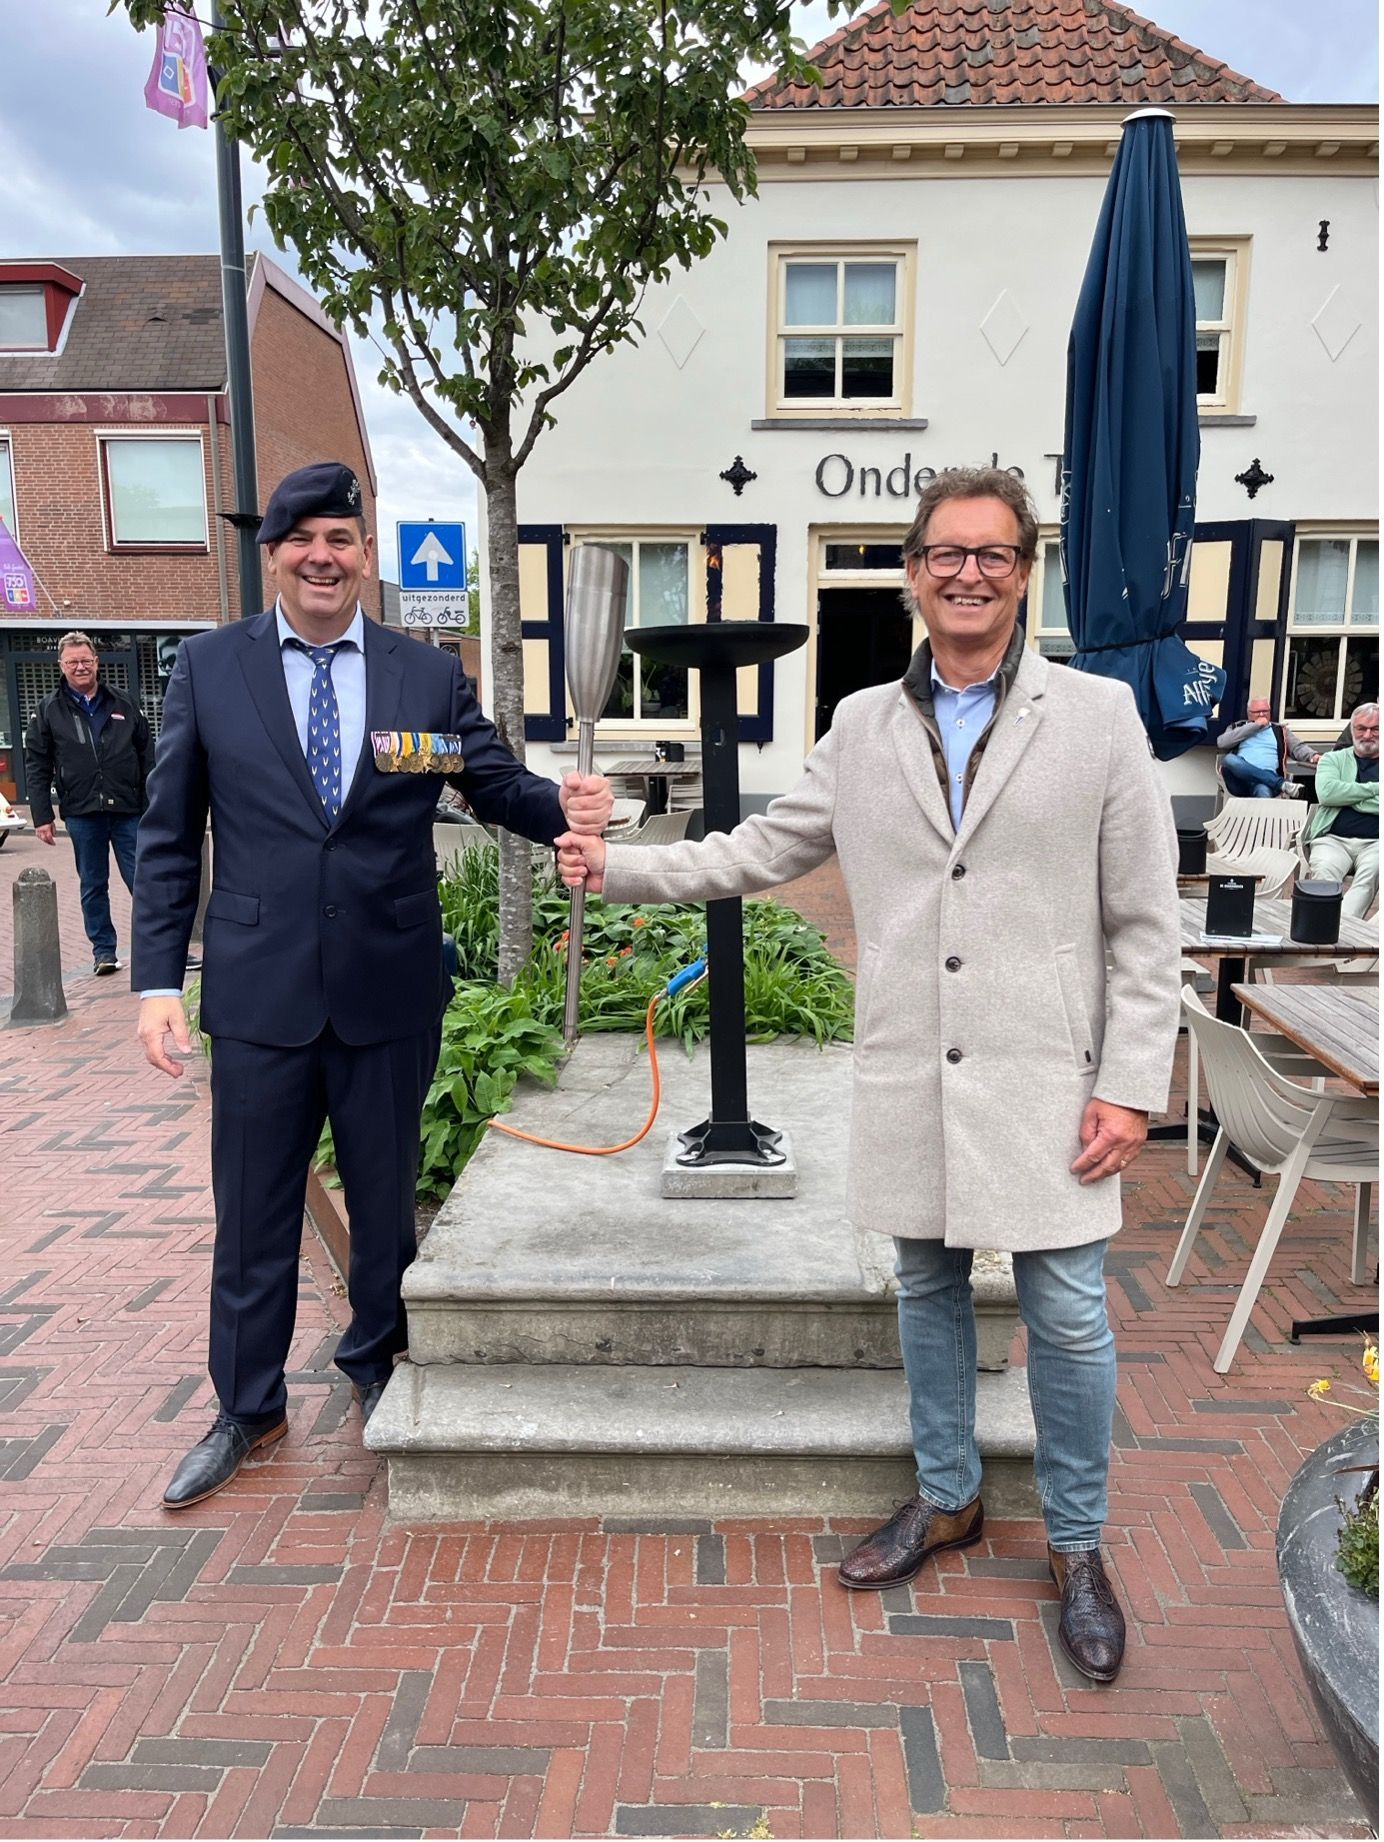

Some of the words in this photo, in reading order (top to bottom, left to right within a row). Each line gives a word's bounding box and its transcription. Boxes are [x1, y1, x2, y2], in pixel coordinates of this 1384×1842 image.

[816, 453, 957, 497] Onde
[7, 577, 24, 588] 750
[402, 594, 466, 604] uitgezonderd
